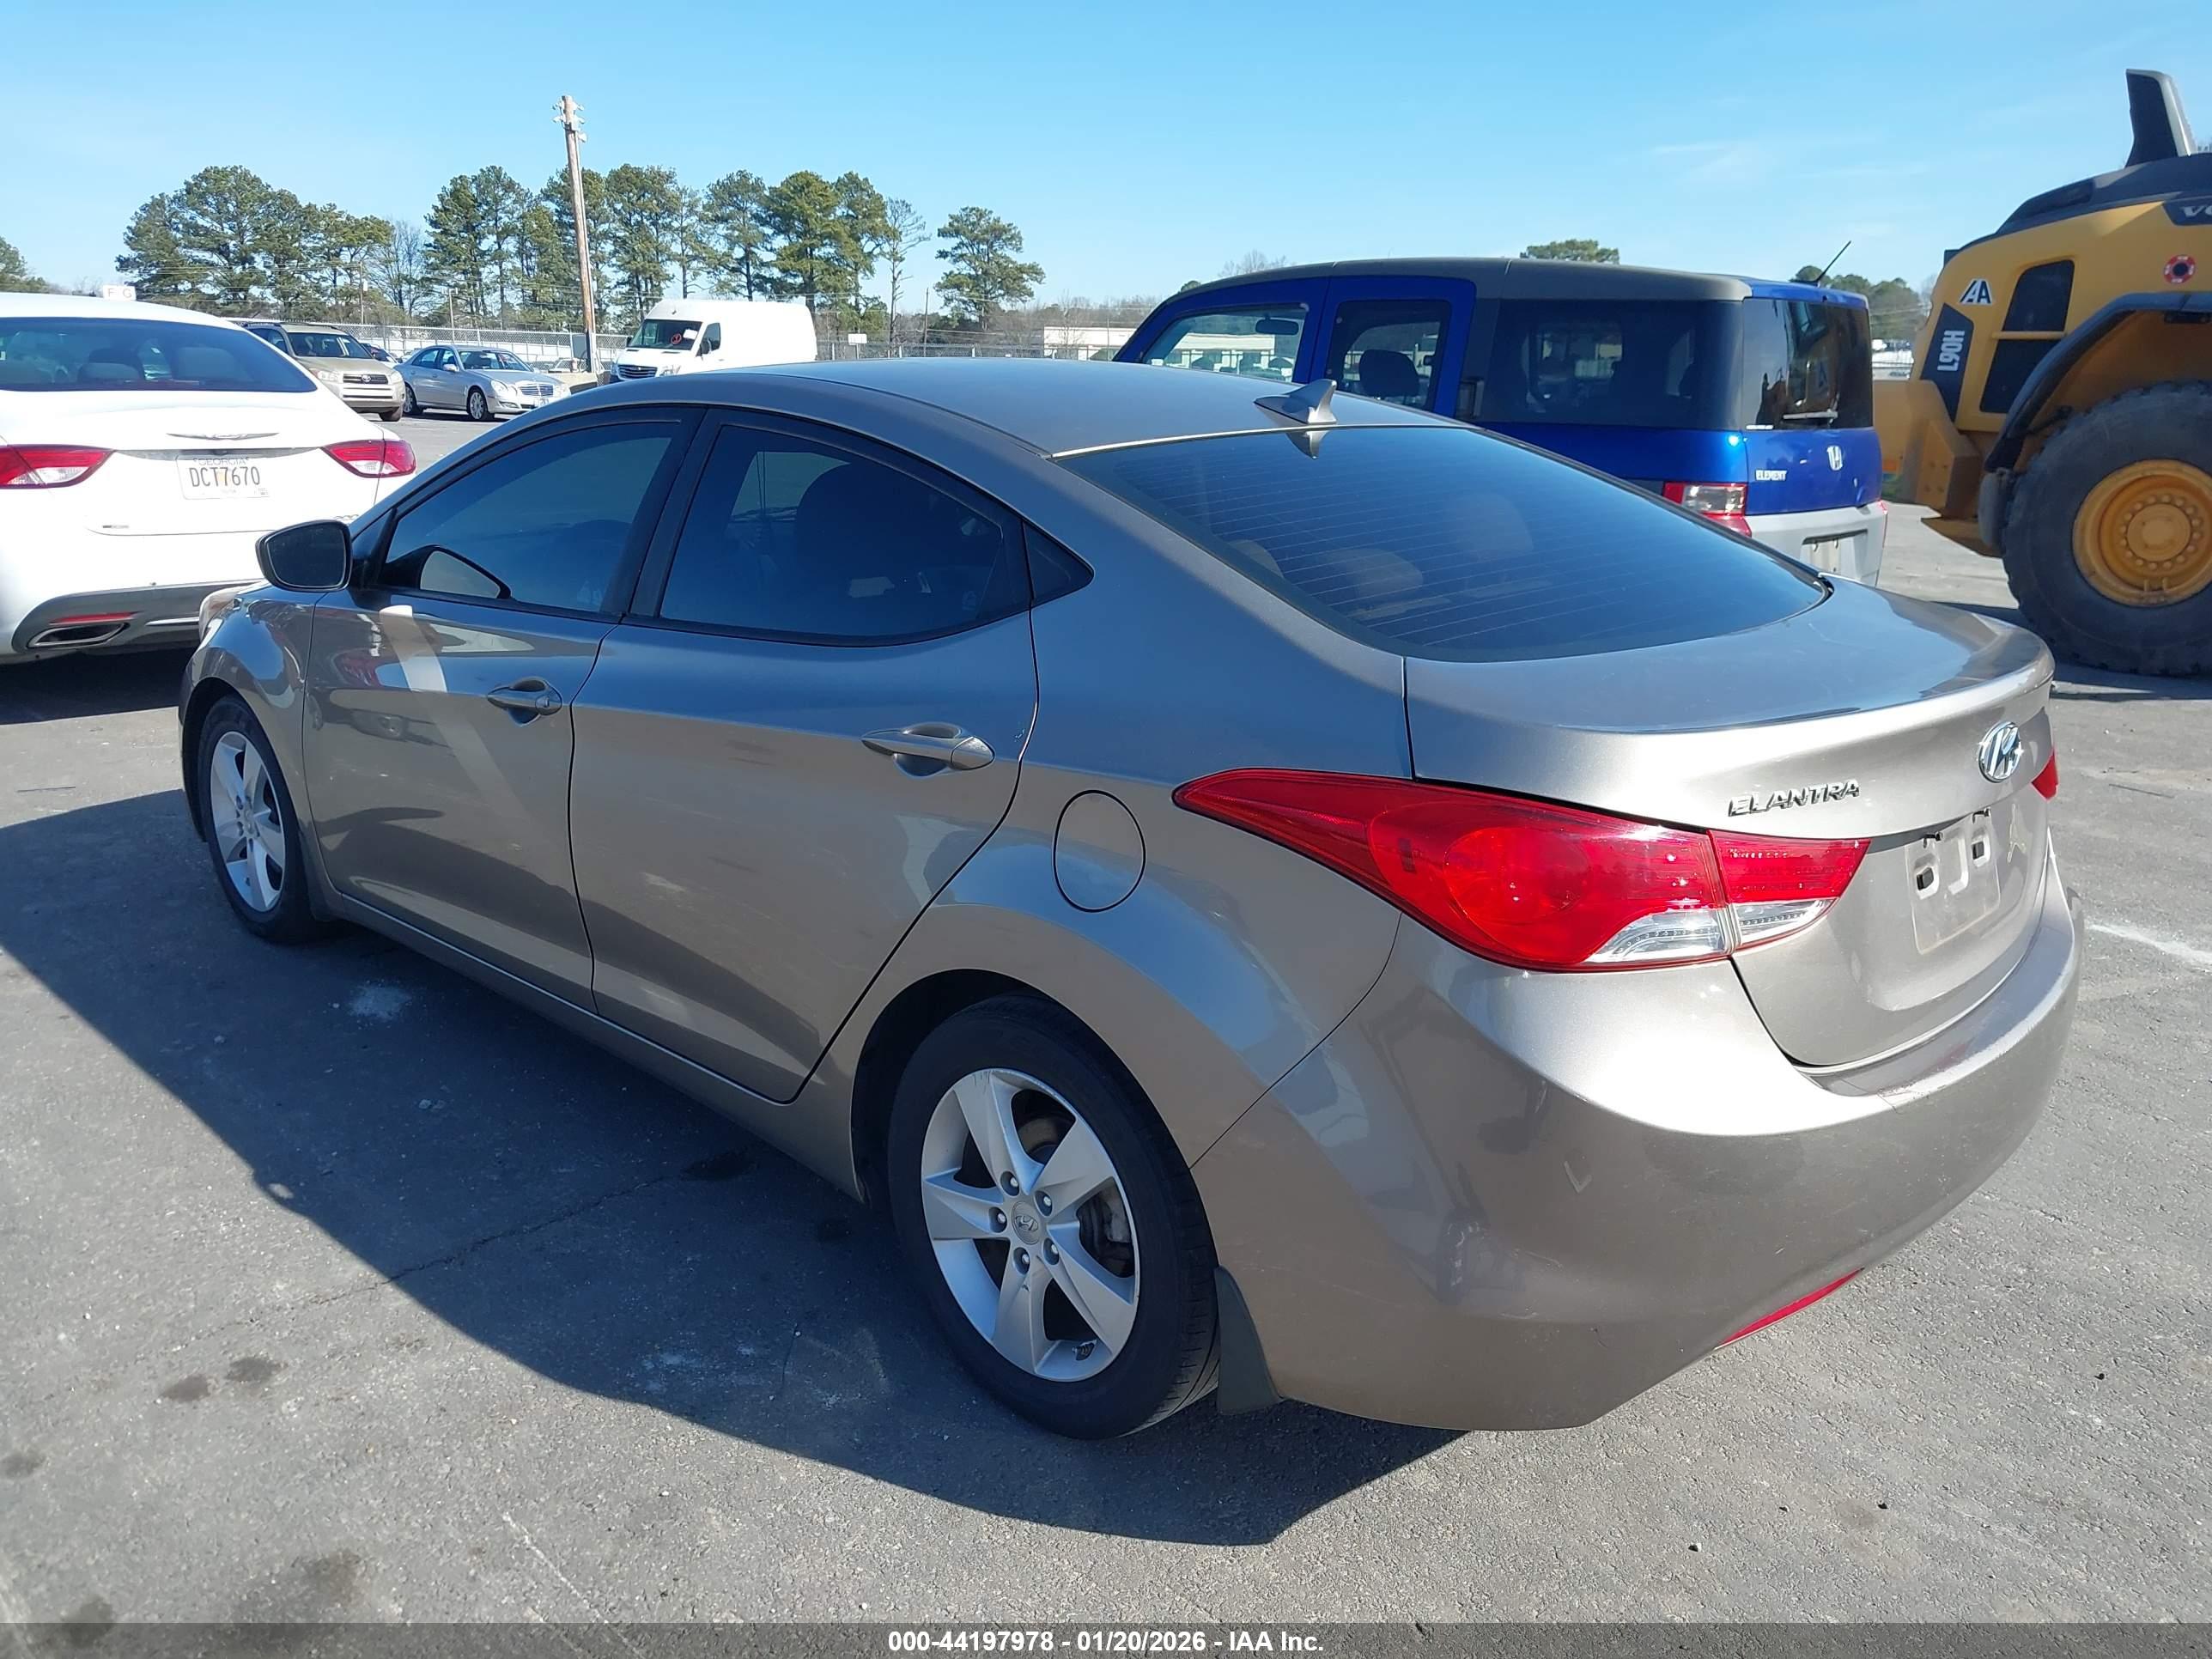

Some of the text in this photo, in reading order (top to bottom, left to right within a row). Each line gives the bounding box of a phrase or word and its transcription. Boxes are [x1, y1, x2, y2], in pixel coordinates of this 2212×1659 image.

[1937, 330, 1966, 372] L90H
[198, 457, 247, 466] GEORGIA
[189, 465, 261, 488] DCT7670
[1755, 470, 1787, 481] ELEMENT
[1728, 779, 1860, 817] ELANTRA
